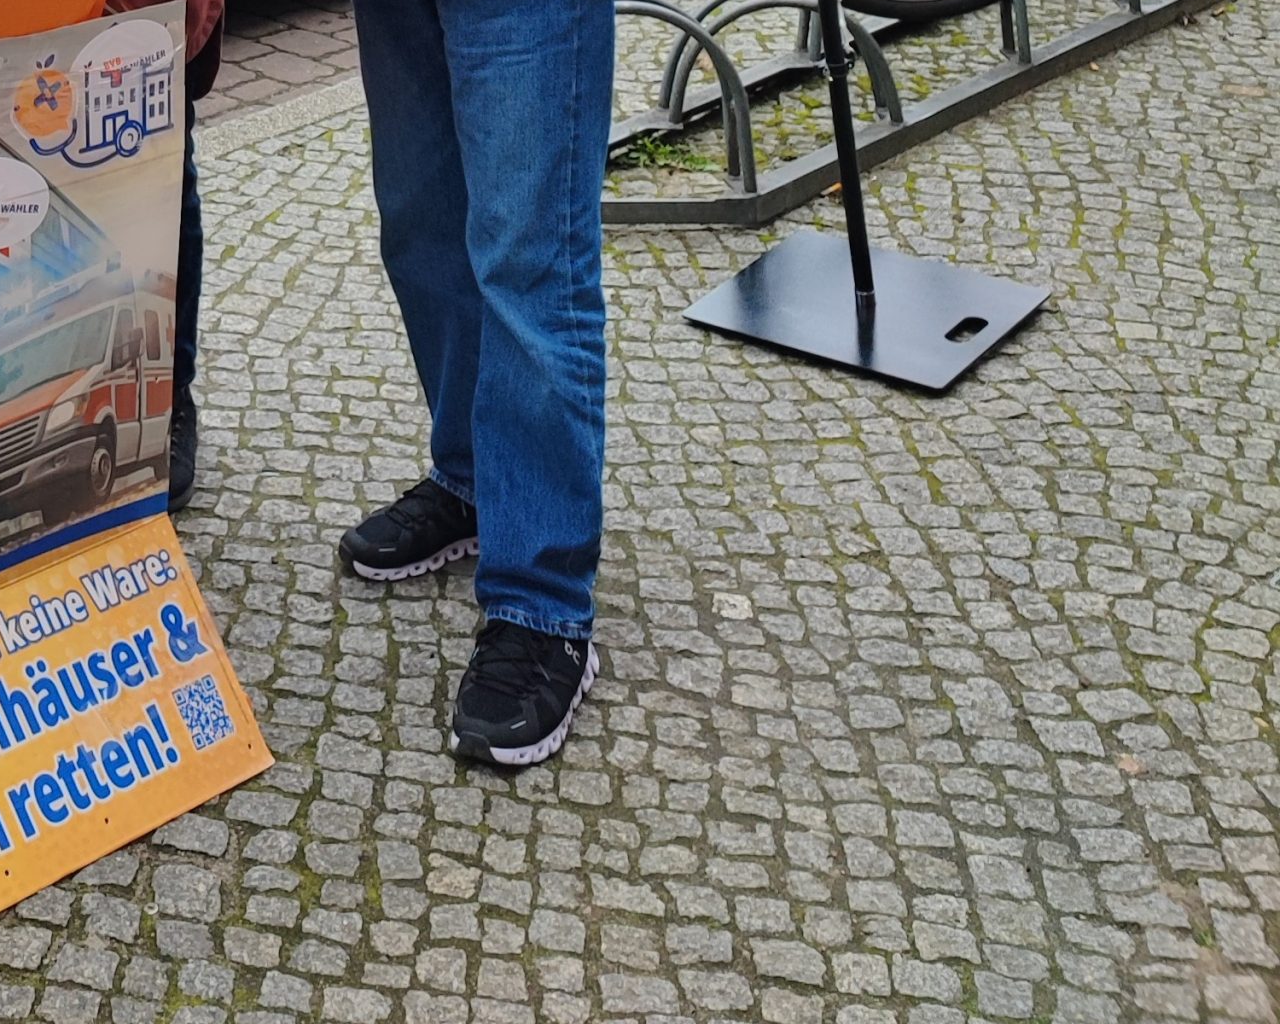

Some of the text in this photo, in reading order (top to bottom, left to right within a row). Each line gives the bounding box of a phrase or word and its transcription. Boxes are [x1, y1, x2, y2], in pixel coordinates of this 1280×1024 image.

[82, 549, 178, 613] Ware:
[159, 604, 210, 663] &
[8, 703, 180, 839] retten!
